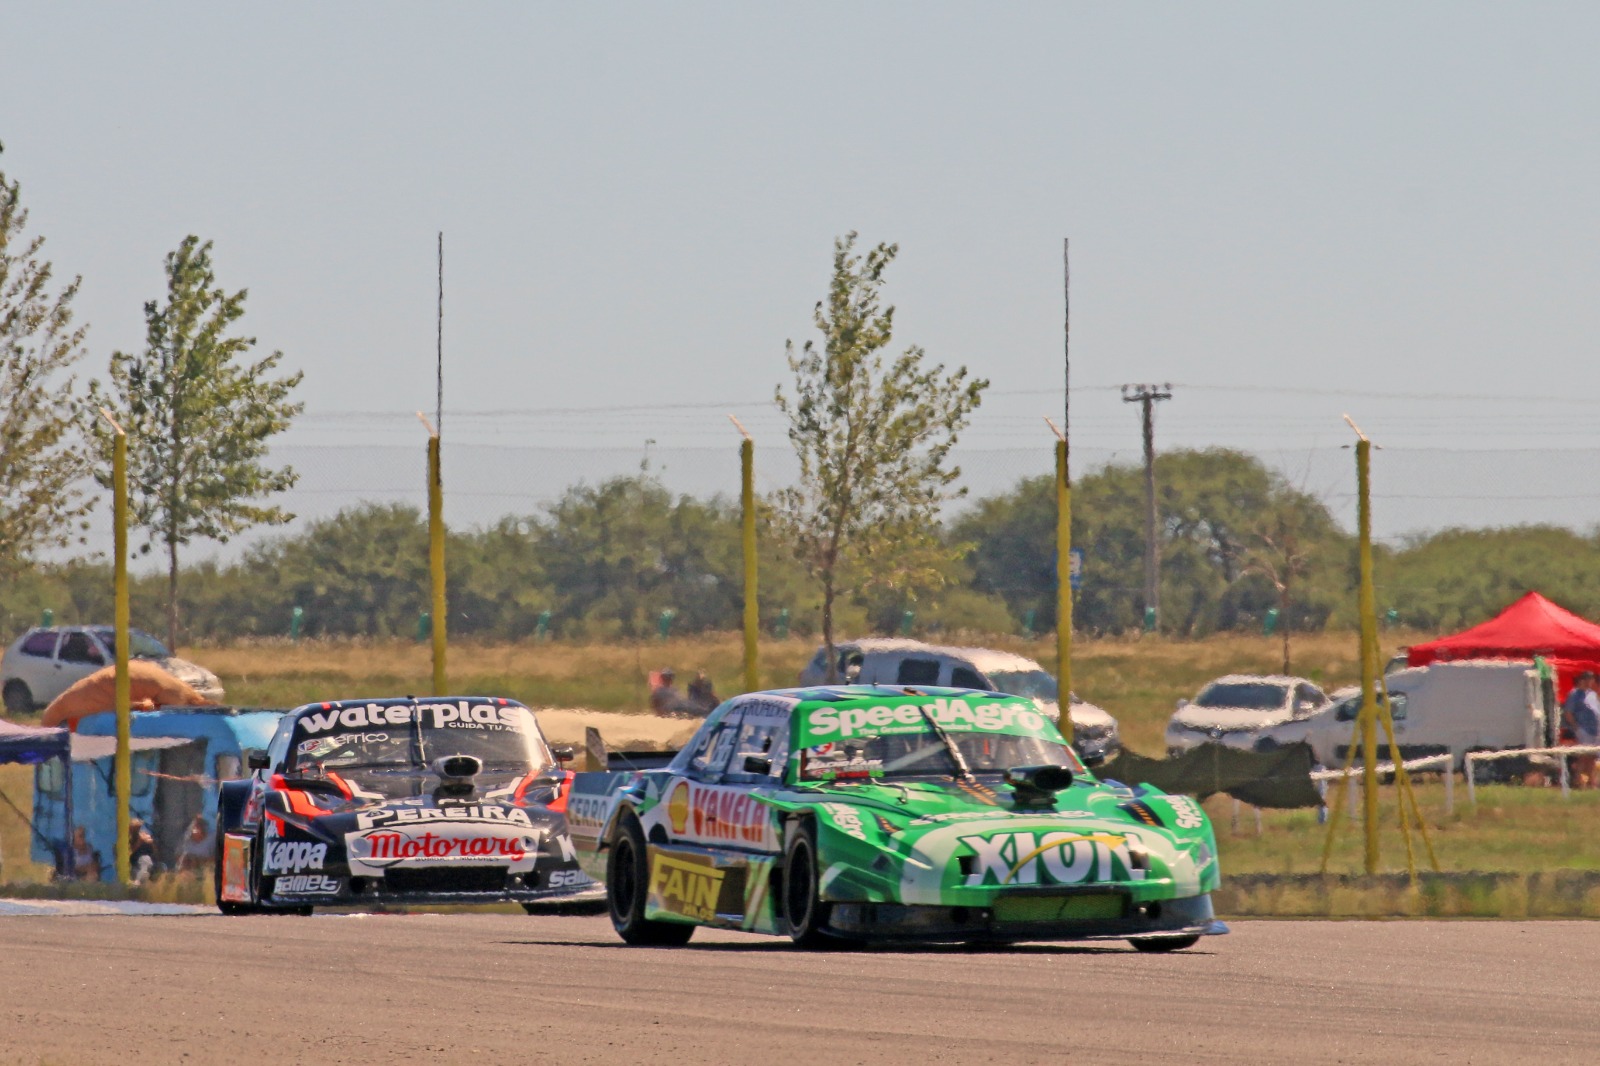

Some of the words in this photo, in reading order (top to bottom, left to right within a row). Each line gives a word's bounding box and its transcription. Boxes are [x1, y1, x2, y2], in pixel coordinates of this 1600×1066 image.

[808, 698, 1044, 736] SpeedAgro
[357, 806, 532, 829] PEREIRA
[264, 841, 327, 874] Kappa
[366, 832, 526, 862] Motorarg
[961, 832, 1145, 885] XION
[648, 854, 725, 910] FAIN
